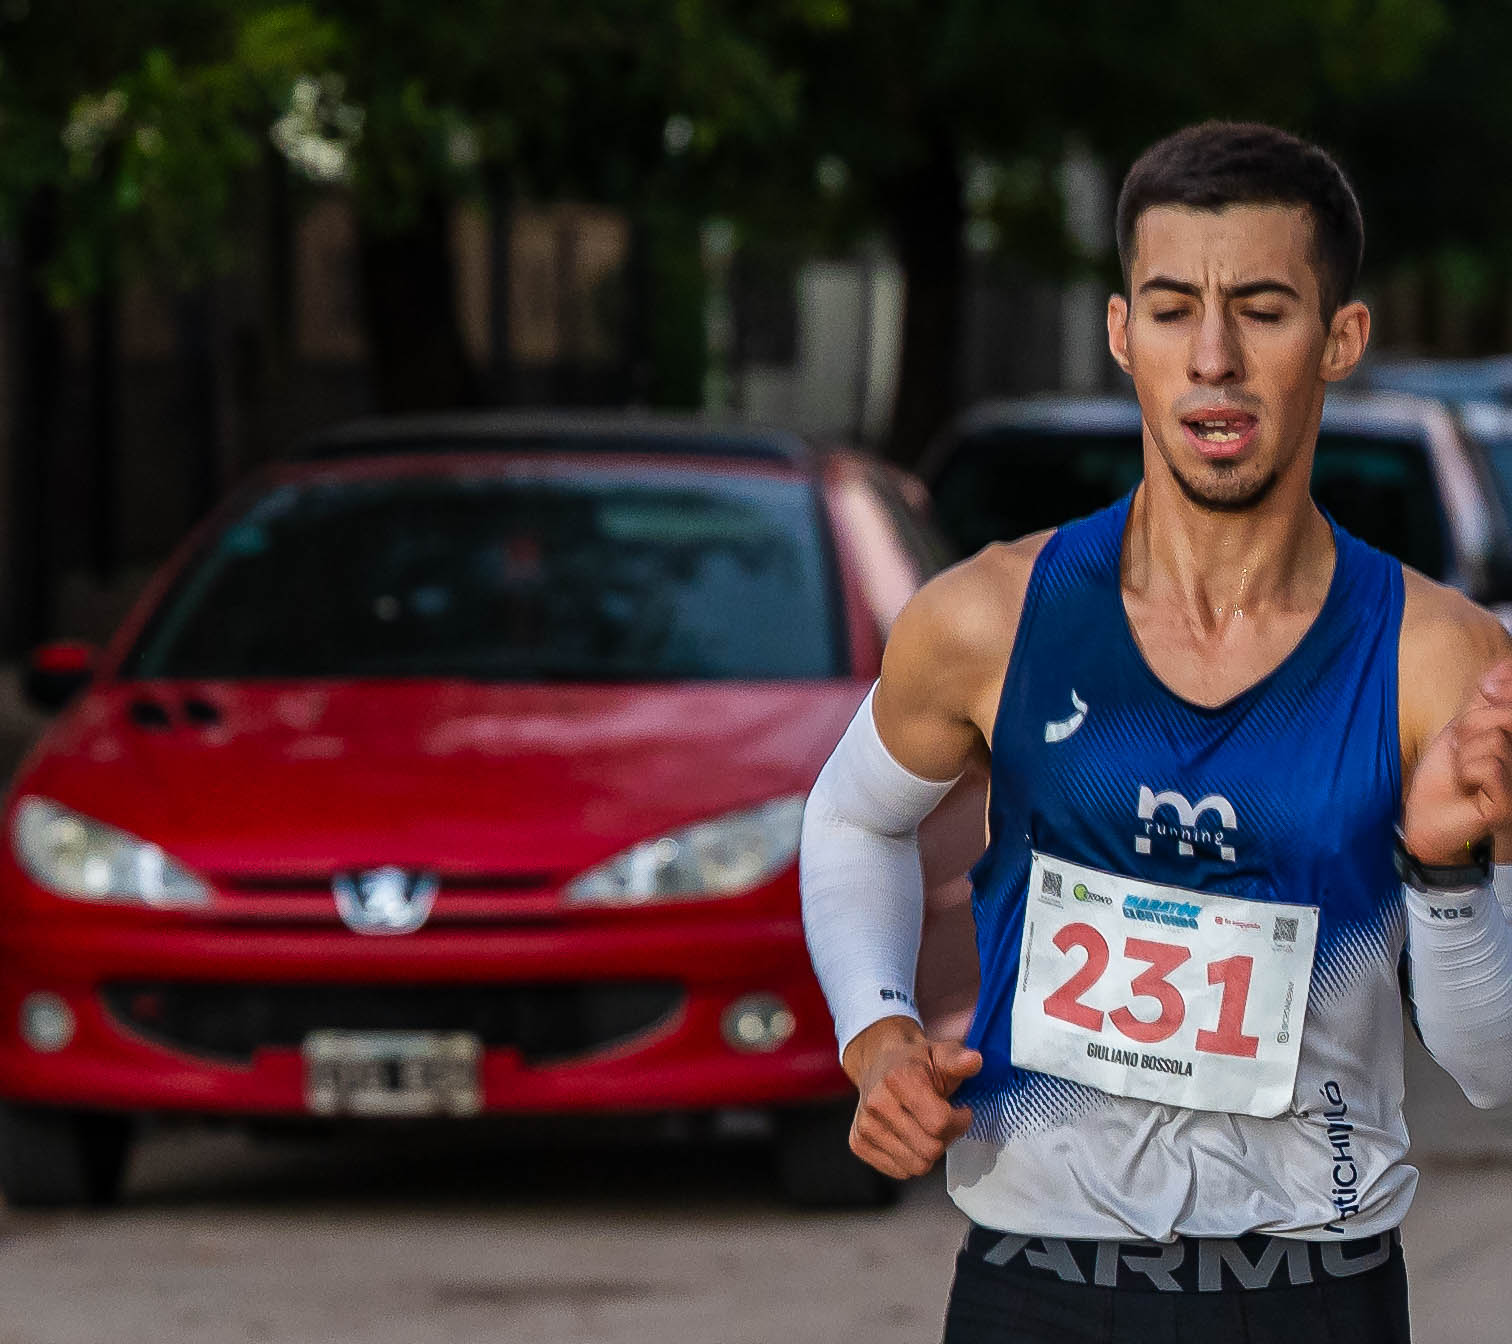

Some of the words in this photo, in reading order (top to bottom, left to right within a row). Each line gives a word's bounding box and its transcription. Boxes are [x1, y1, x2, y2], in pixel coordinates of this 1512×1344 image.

[1144, 822, 1224, 846] running
[1043, 922, 1259, 1058] 231
[1087, 1042, 1139, 1068] GIULIANO
[1140, 1053, 1193, 1077] BOSSOLA
